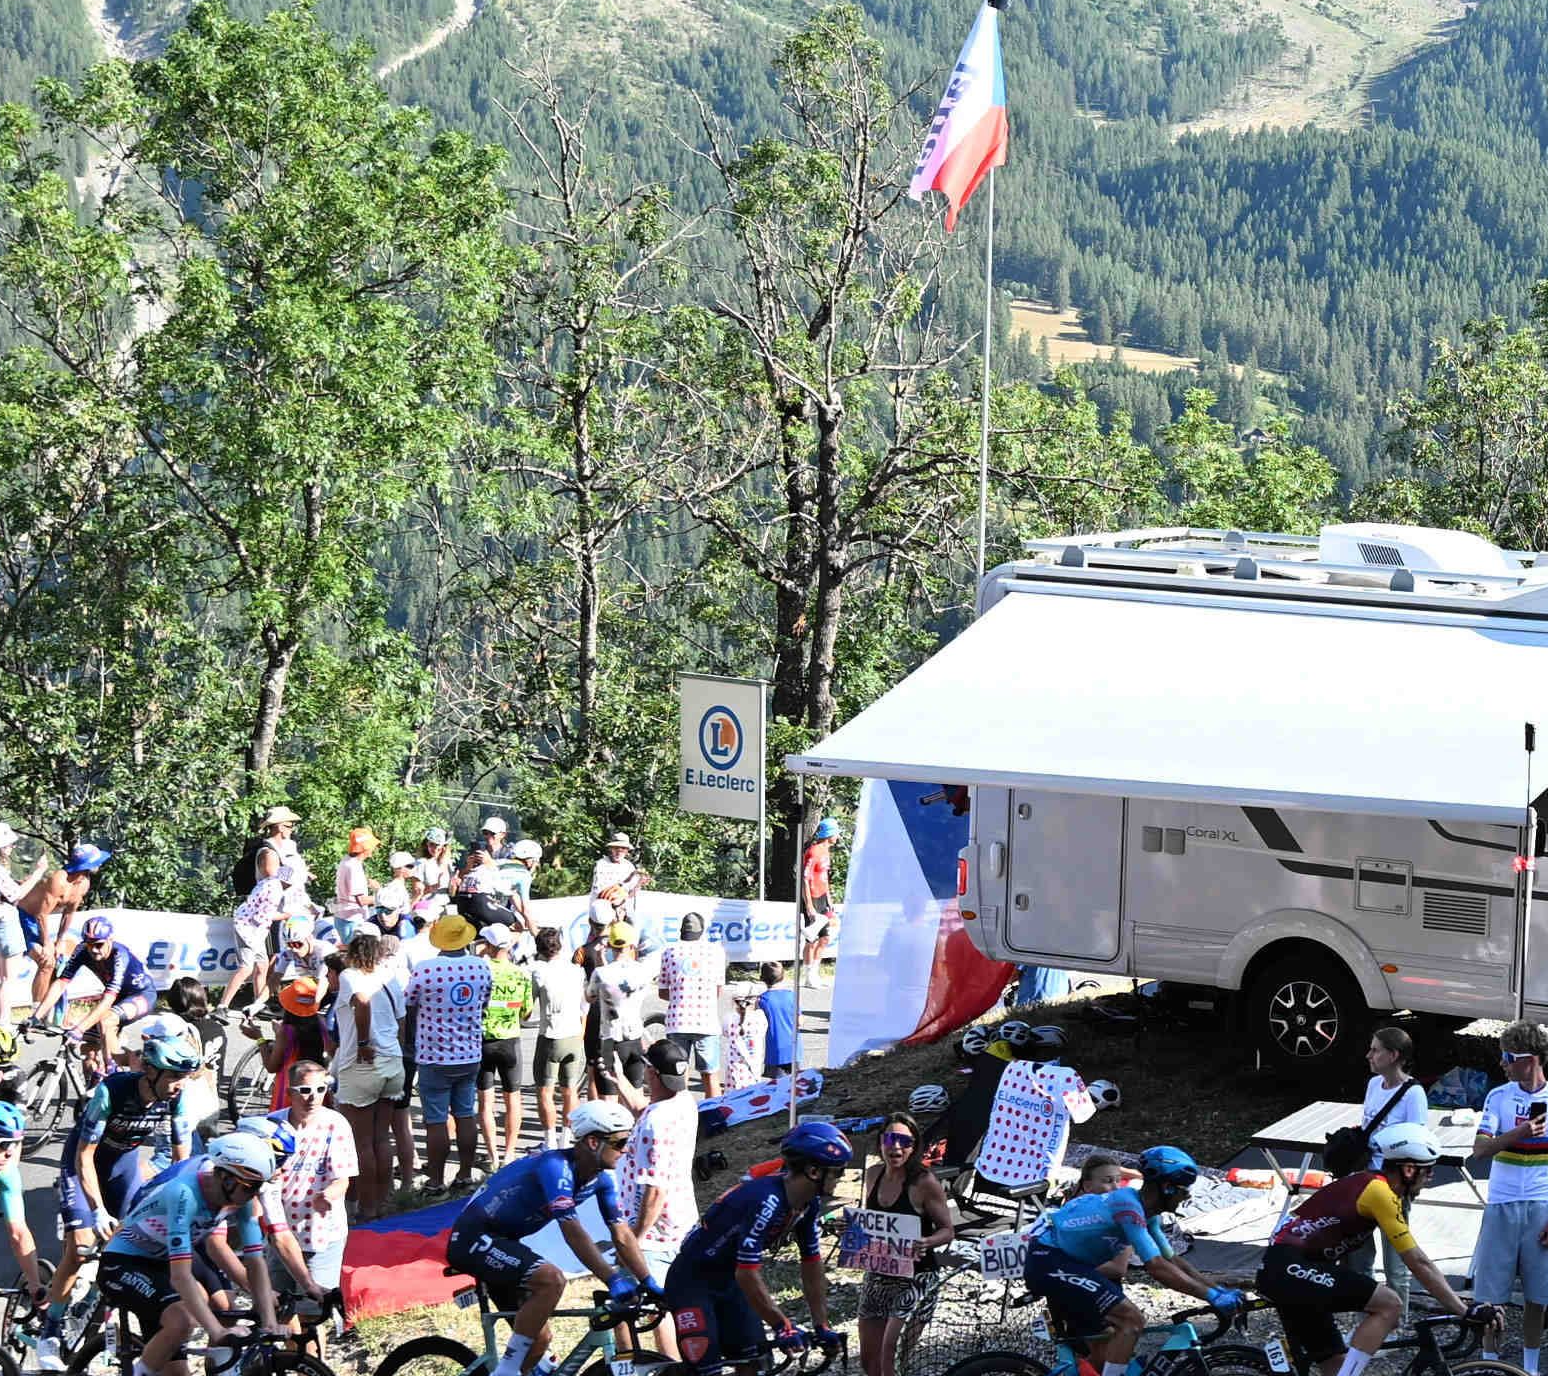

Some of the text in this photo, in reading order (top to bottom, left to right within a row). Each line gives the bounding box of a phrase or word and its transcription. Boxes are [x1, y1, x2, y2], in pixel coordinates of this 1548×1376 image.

[709, 722, 730, 756] L
[685, 768, 756, 793] E.Leclerc
[1186, 826, 1240, 842] Coral XL
[663, 916, 796, 942] Eeclerc
[750, 1193, 780, 1236] raisin
[1062, 1213, 1105, 1228] ASTANA
[1291, 1215, 1341, 1240] Cofidis
[1285, 1263, 1336, 1288] Cofidis
[458, 1291, 474, 1307] 107
[617, 1360, 635, 1375] 213
[1266, 1345, 1285, 1367] 163
